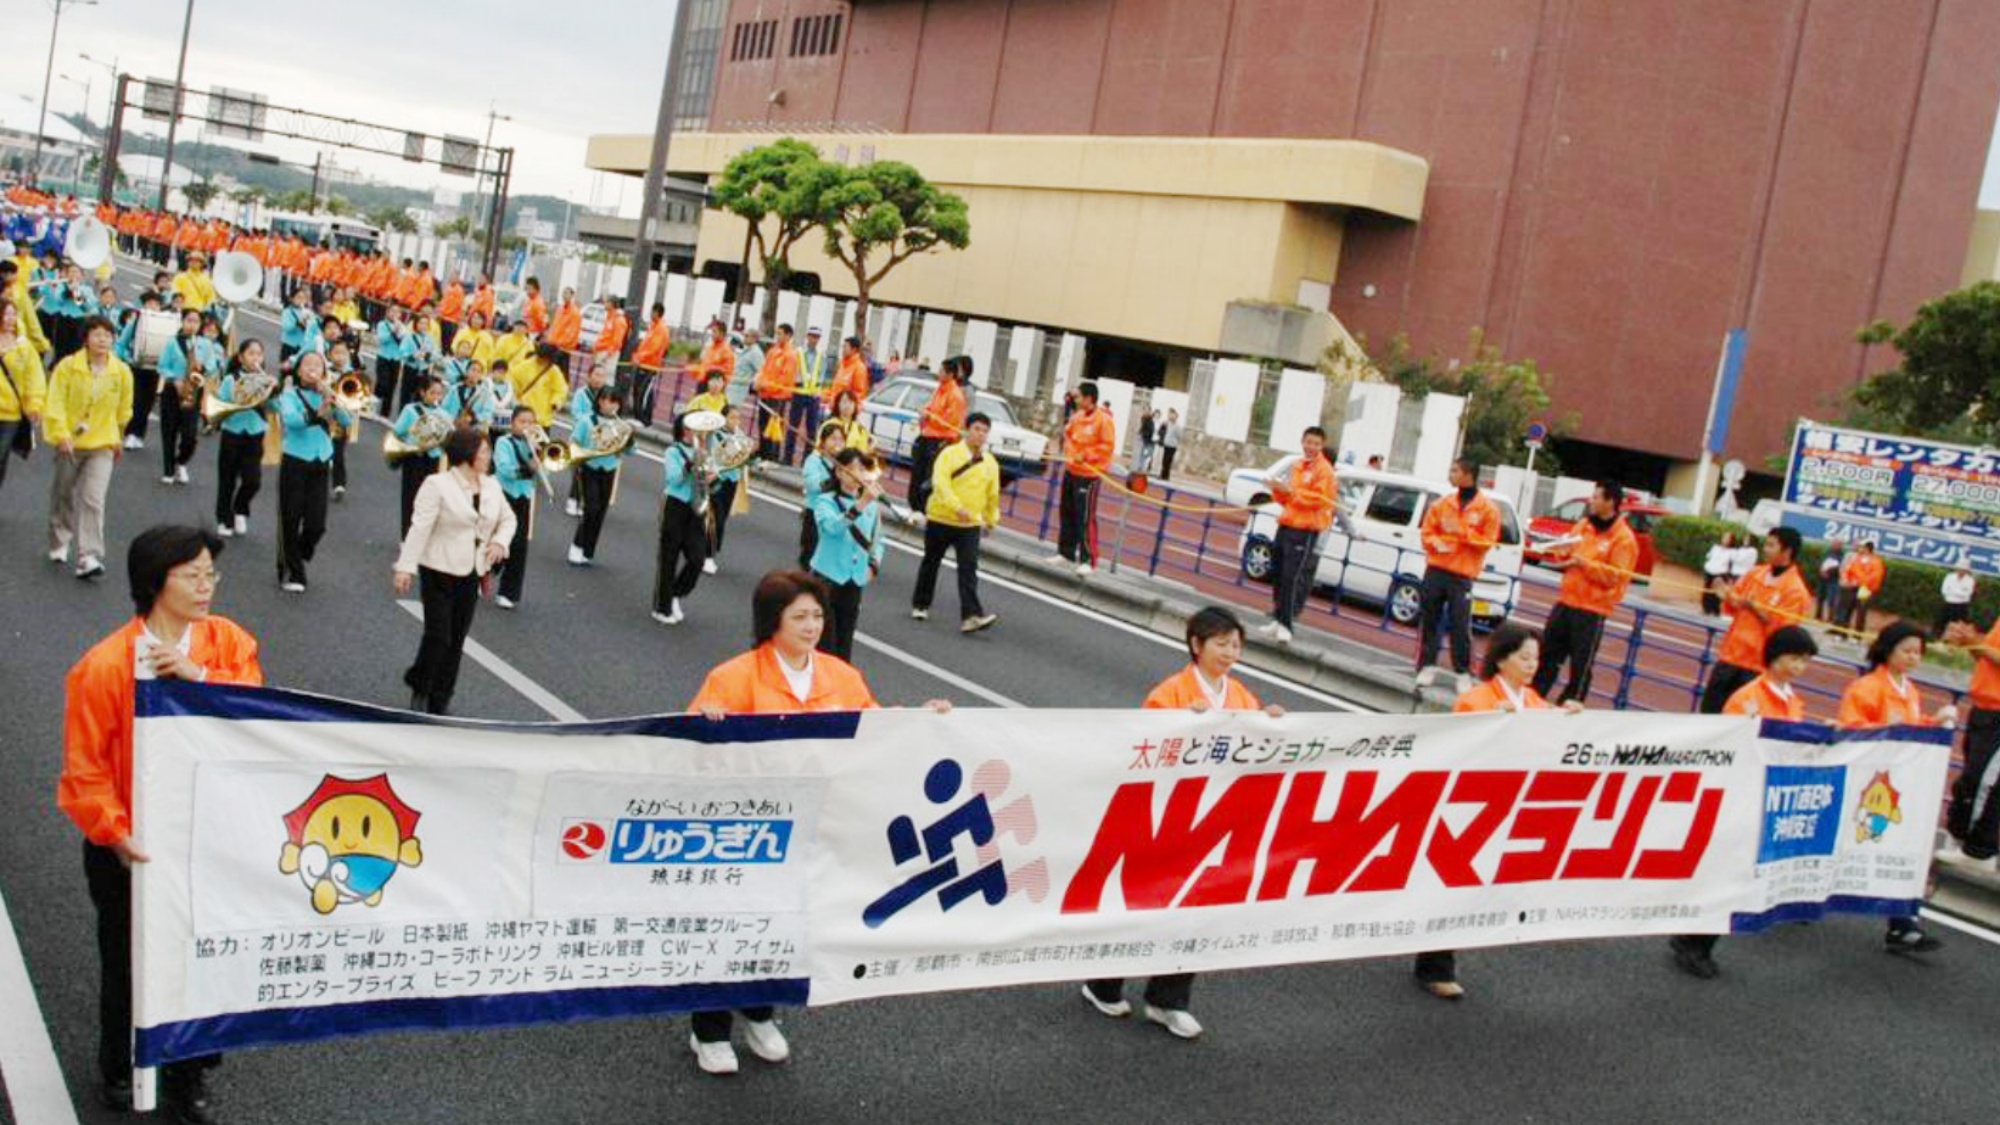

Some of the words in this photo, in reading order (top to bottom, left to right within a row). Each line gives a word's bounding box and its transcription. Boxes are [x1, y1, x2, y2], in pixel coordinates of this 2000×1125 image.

[617, 822, 783, 861] りゅうぎん
[1060, 770, 1723, 914] NAHAマラソン
[261, 928, 386, 951] オリオンビール
[402, 922, 470, 943] 日本製紙
